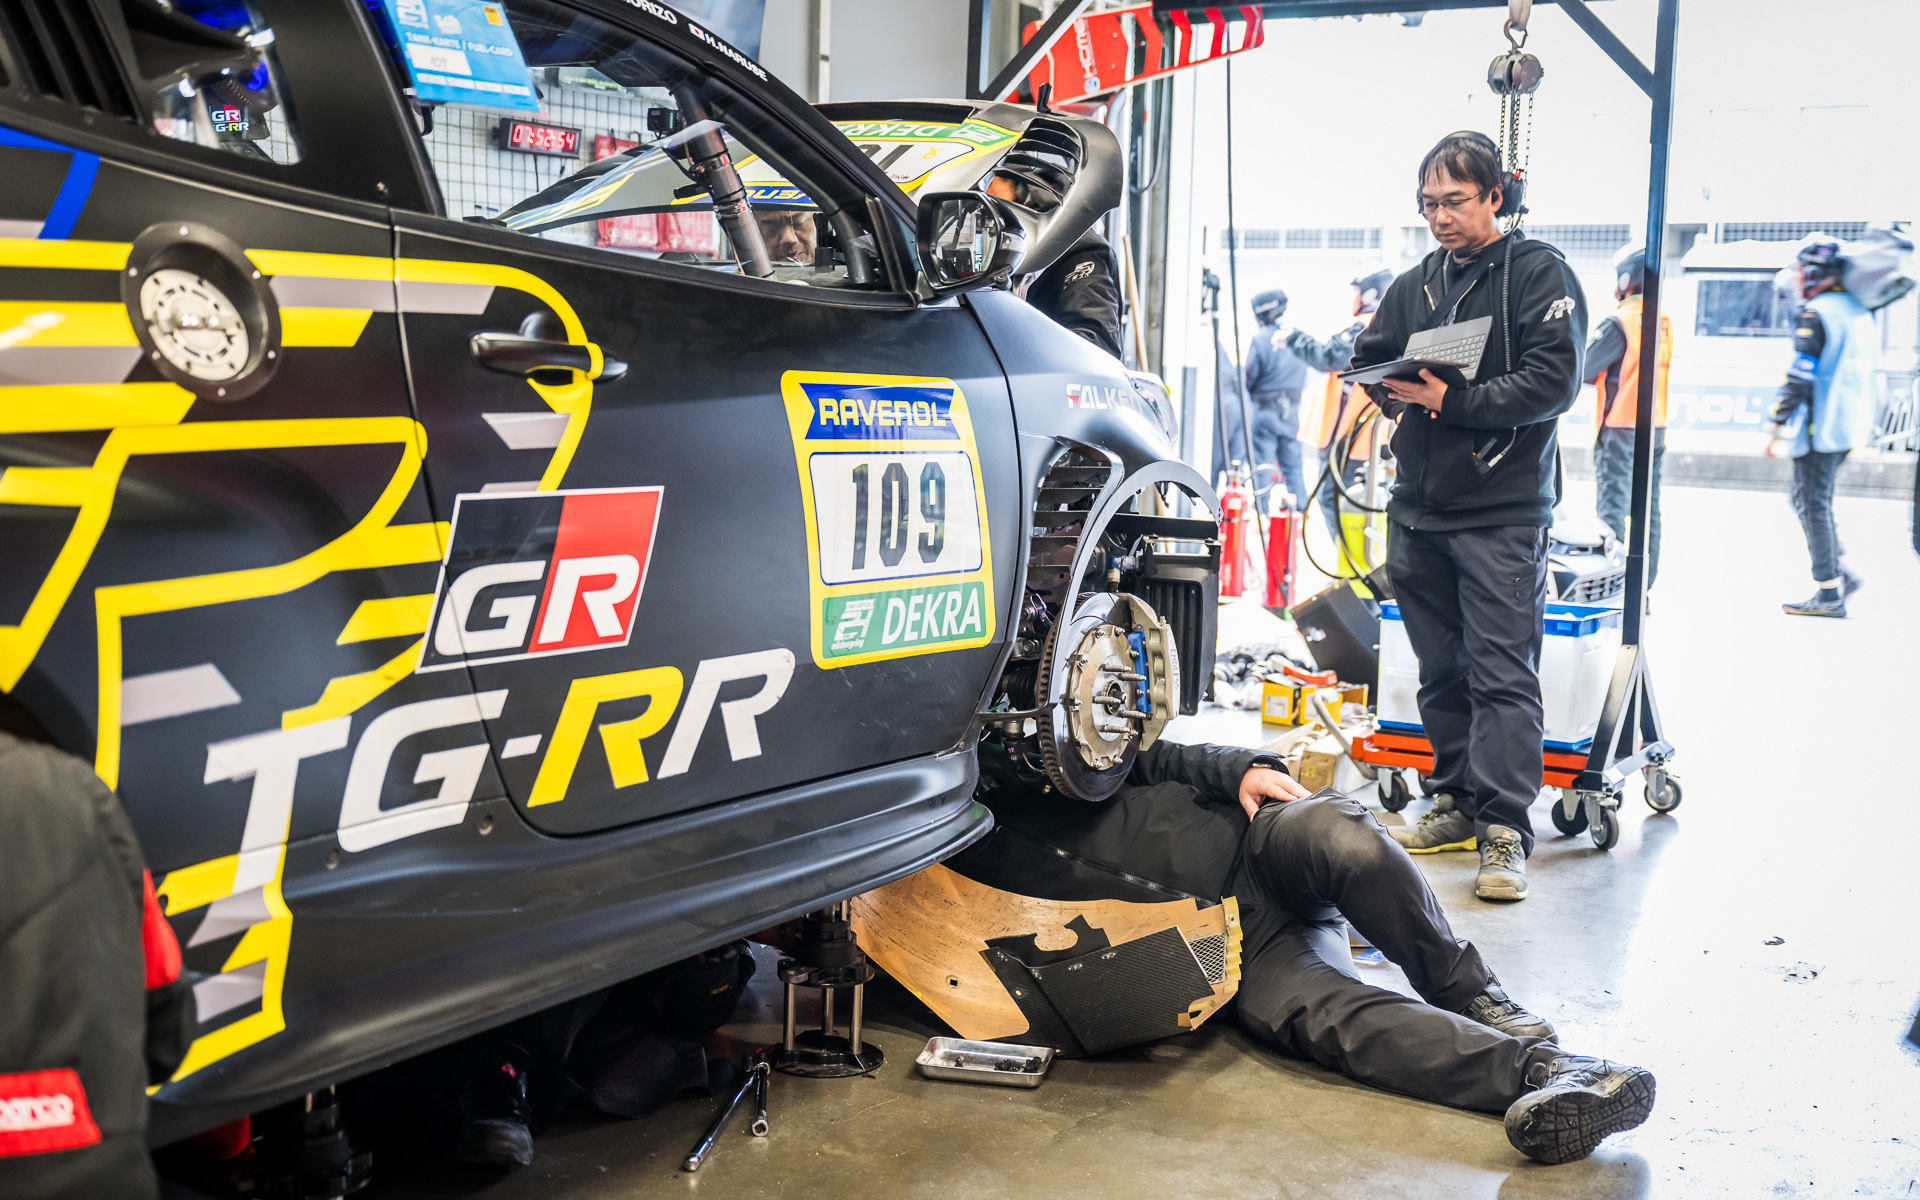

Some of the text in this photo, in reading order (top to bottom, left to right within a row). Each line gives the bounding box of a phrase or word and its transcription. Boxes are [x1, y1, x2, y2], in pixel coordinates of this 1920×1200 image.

[624, 0, 678, 25] ORIZO
[704, 33, 769, 83] H.NARUSE
[212, 110, 240, 121] GR
[213, 122, 249, 132] G-RR
[819, 397, 947, 427] RAVENOL
[1064, 383, 1144, 414] FALKEN
[850, 460, 947, 573] 109
[434, 553, 640, 656] GR
[881, 587, 982, 645] DEKRA
[203, 647, 797, 895] TG-RR
